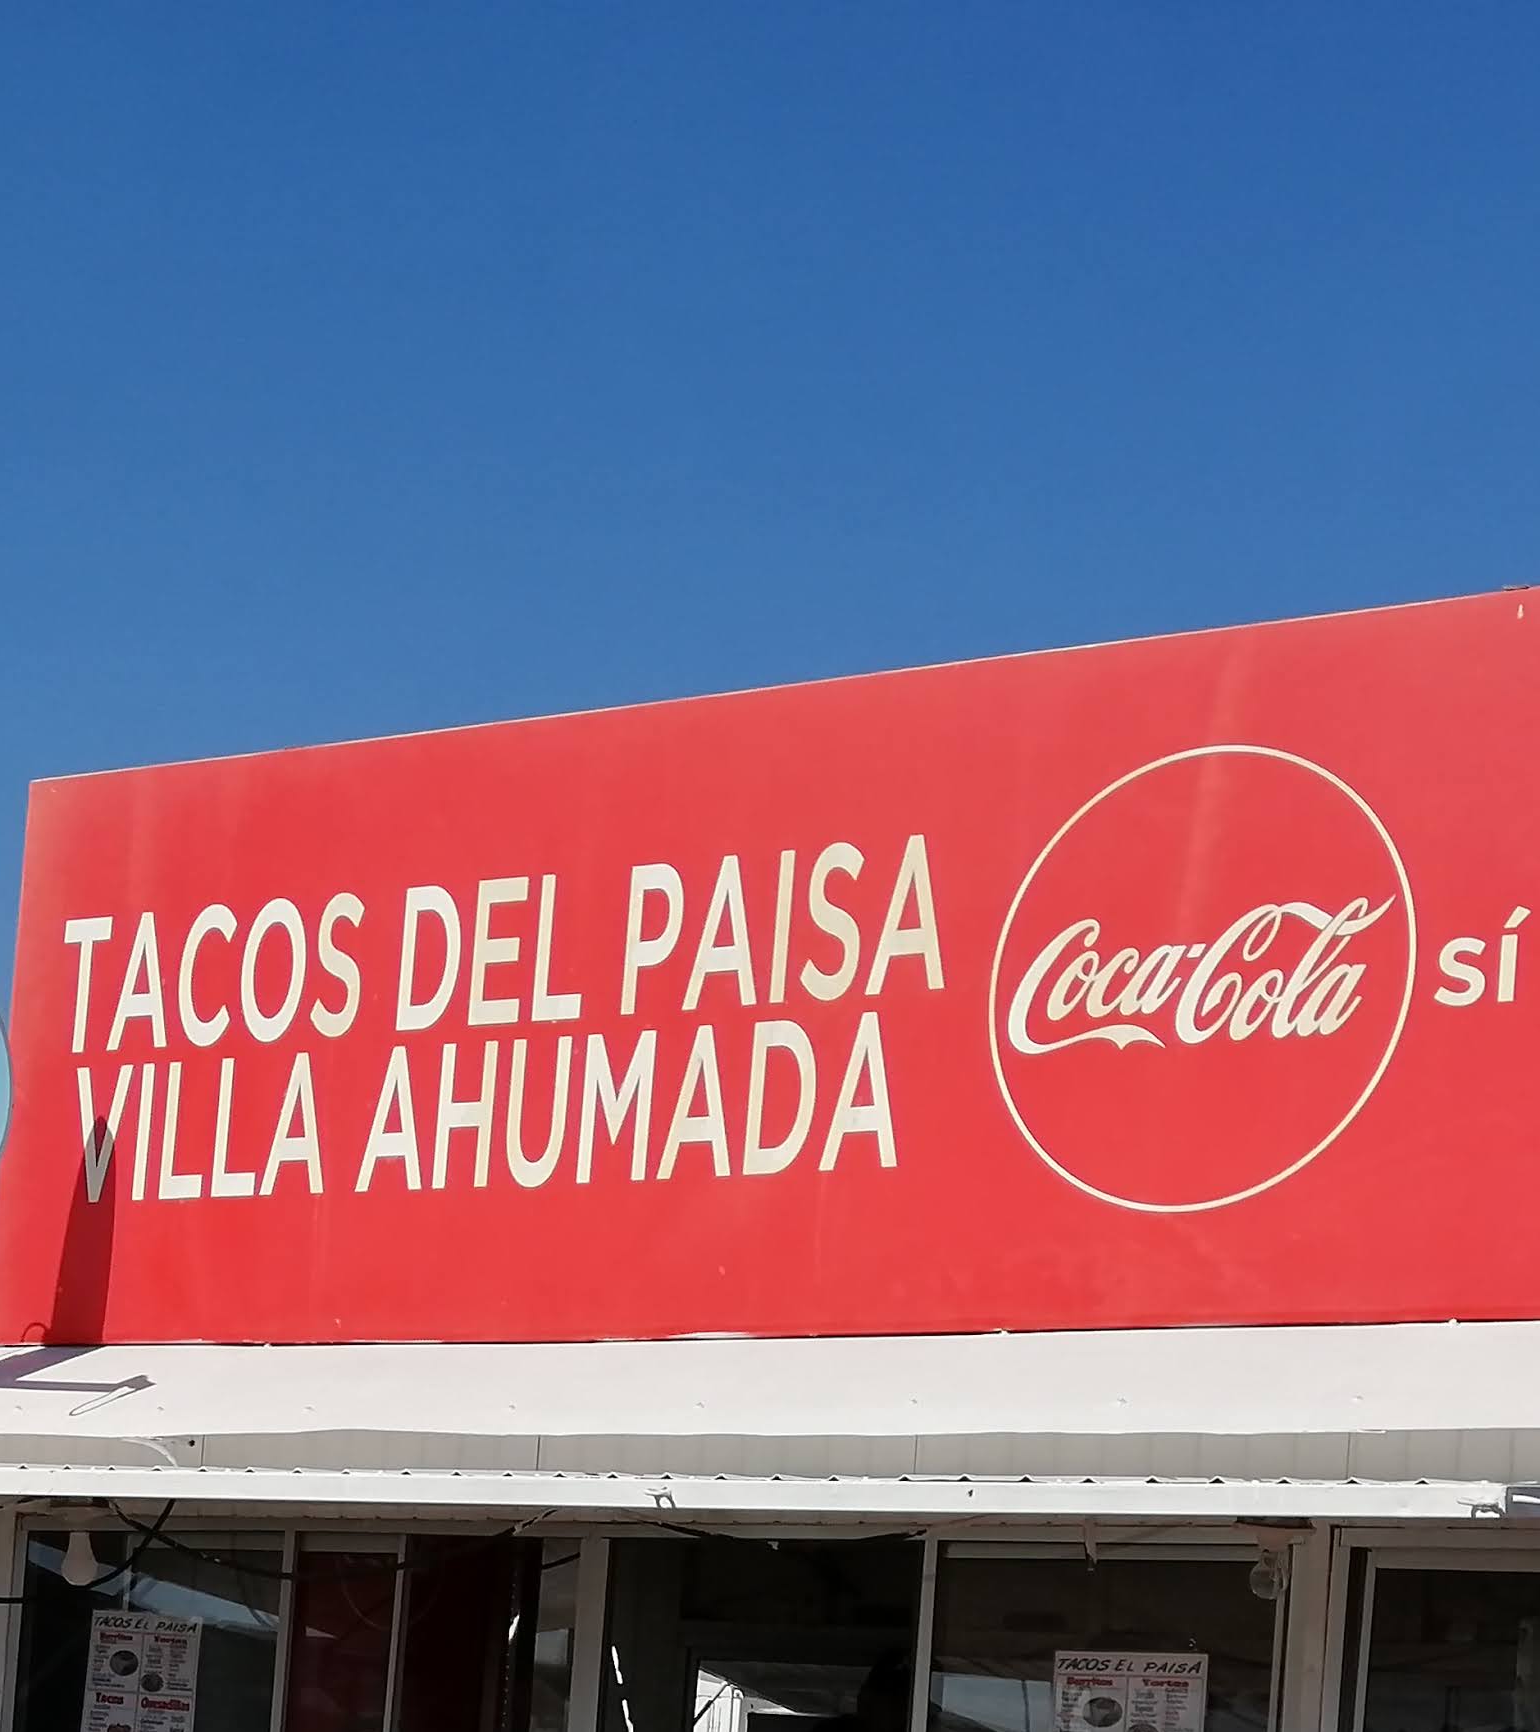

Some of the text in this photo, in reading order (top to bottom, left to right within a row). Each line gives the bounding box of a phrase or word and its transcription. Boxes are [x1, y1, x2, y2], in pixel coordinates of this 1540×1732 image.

[64, 834, 945, 1053] TACOS DEL PAISA
[1008, 893, 1396, 1054] Coca-Cola
[1433, 905, 1531, 1006] sí
[77, 1011, 897, 1203] VILLA AHUMADA
[94, 1616, 198, 1633] TACOS EL PAISA
[1058, 1657, 1203, 1675] TACOS EL PAISA
[1142, 1678, 1190, 1688] Tortas
